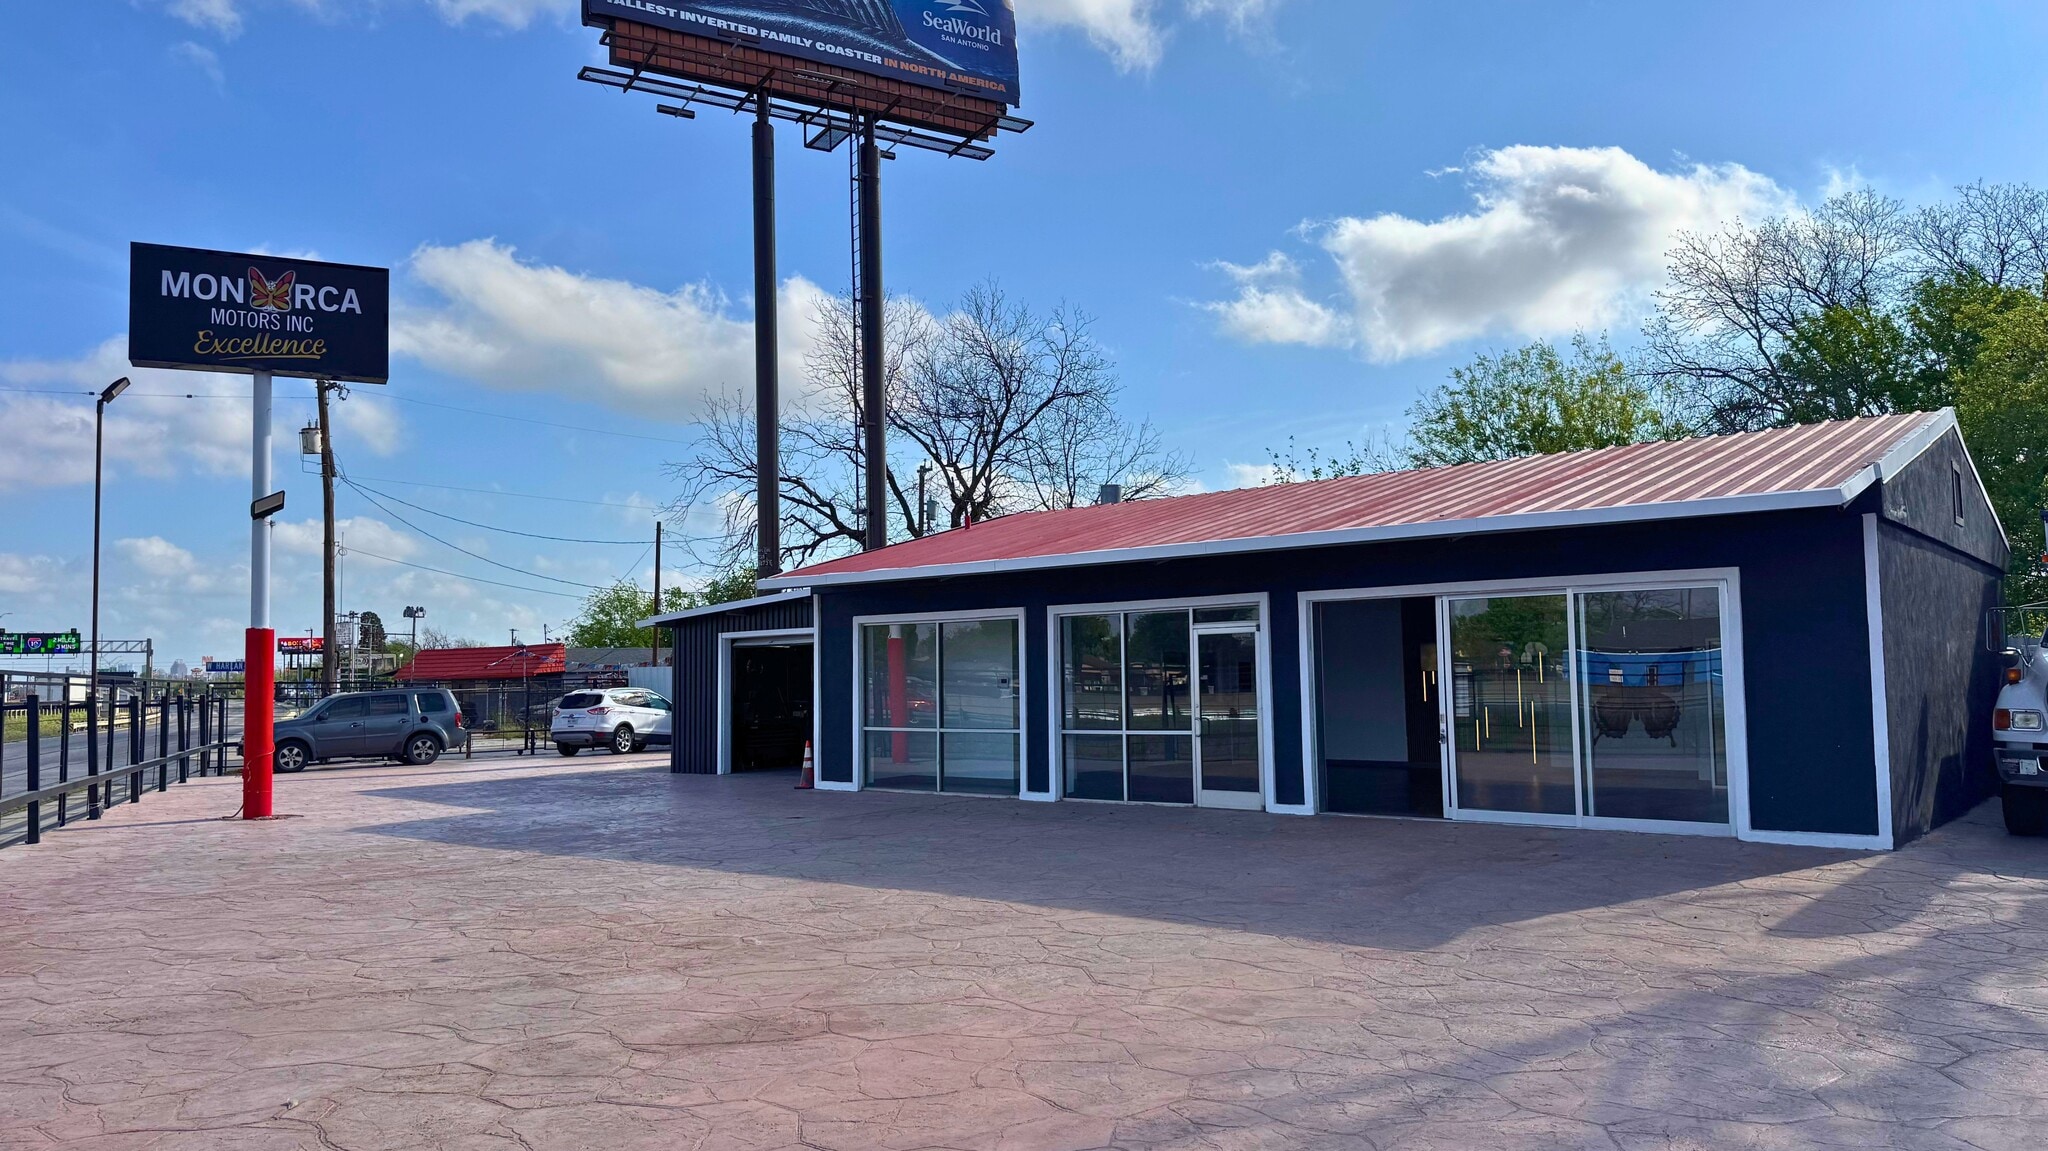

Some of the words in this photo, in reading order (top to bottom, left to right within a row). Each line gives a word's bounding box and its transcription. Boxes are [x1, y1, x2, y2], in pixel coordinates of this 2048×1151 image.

[922, 10, 1001, 46] SeaWorld
[680, 10, 758, 36] INVERTED
[760, 29, 813, 48] FAMILY
[815, 42, 882, 65] COASTER
[884, 57, 898, 69] IN
[900, 61, 947, 79] NORTH
[949, 73, 1007, 93] AMERICA
[941, 34, 956, 43] SAN
[957, 37, 990, 52] ANTONIO
[211, 307, 280, 331] MOTORS
[286, 315, 314, 333] INC
[194, 329, 327, 355] Excellence
[216, 662, 244, 671] HARLAN
